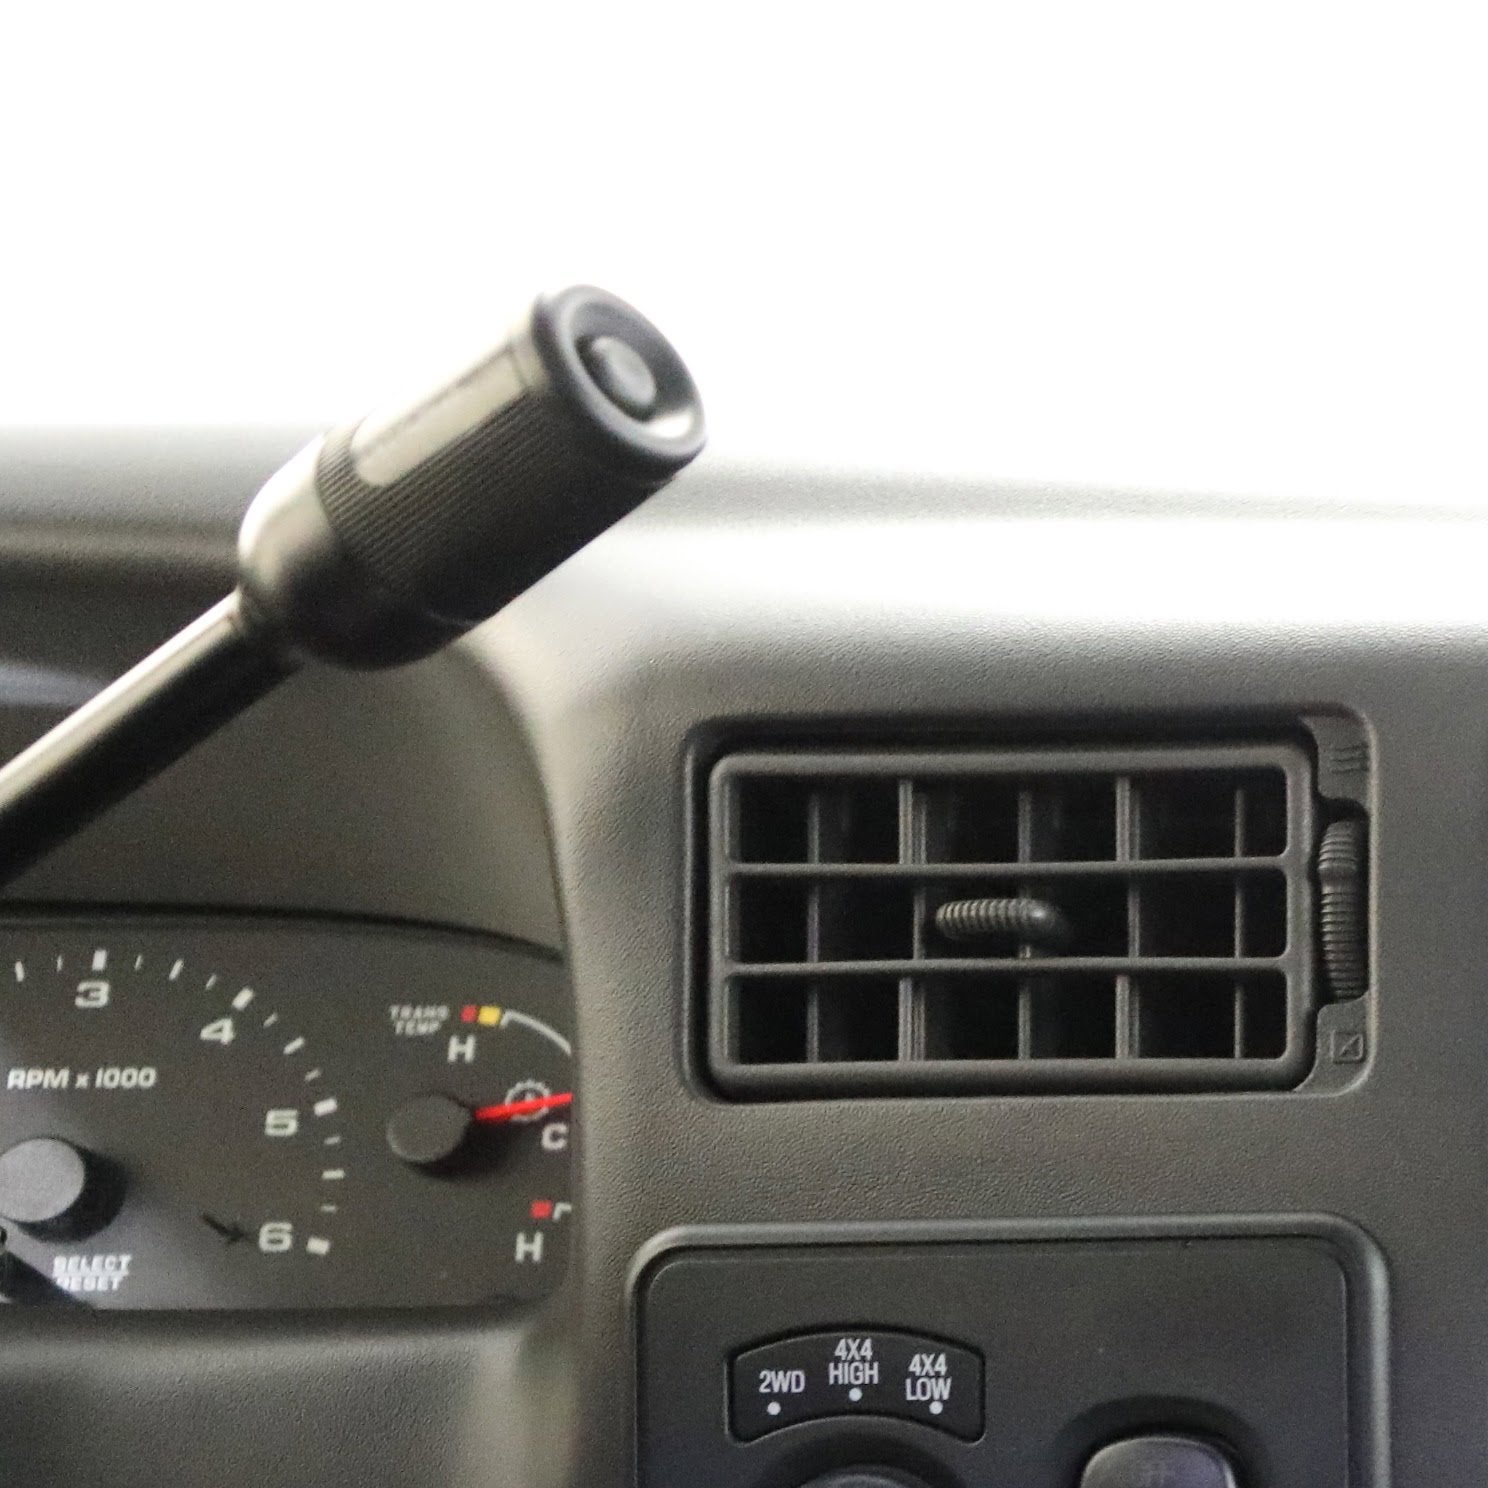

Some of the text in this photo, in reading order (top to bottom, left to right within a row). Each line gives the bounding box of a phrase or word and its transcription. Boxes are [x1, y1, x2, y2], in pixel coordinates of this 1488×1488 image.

[75, 980, 110, 1009] 3
[200, 1018, 234, 1045] 4
[447, 1035, 475, 1063] H
[7, 1068, 70, 1089] RPM
[95, 1067, 157, 1089] 1000
[265, 1109, 298, 1137] 5
[541, 1122, 568, 1150] C
[258, 1222, 293, 1253] 6
[514, 1231, 544, 1263] H
[759, 1371, 806, 1394] 2WD
[828, 1361, 879, 1386] HIGH
[905, 1377, 951, 1401] LOW
